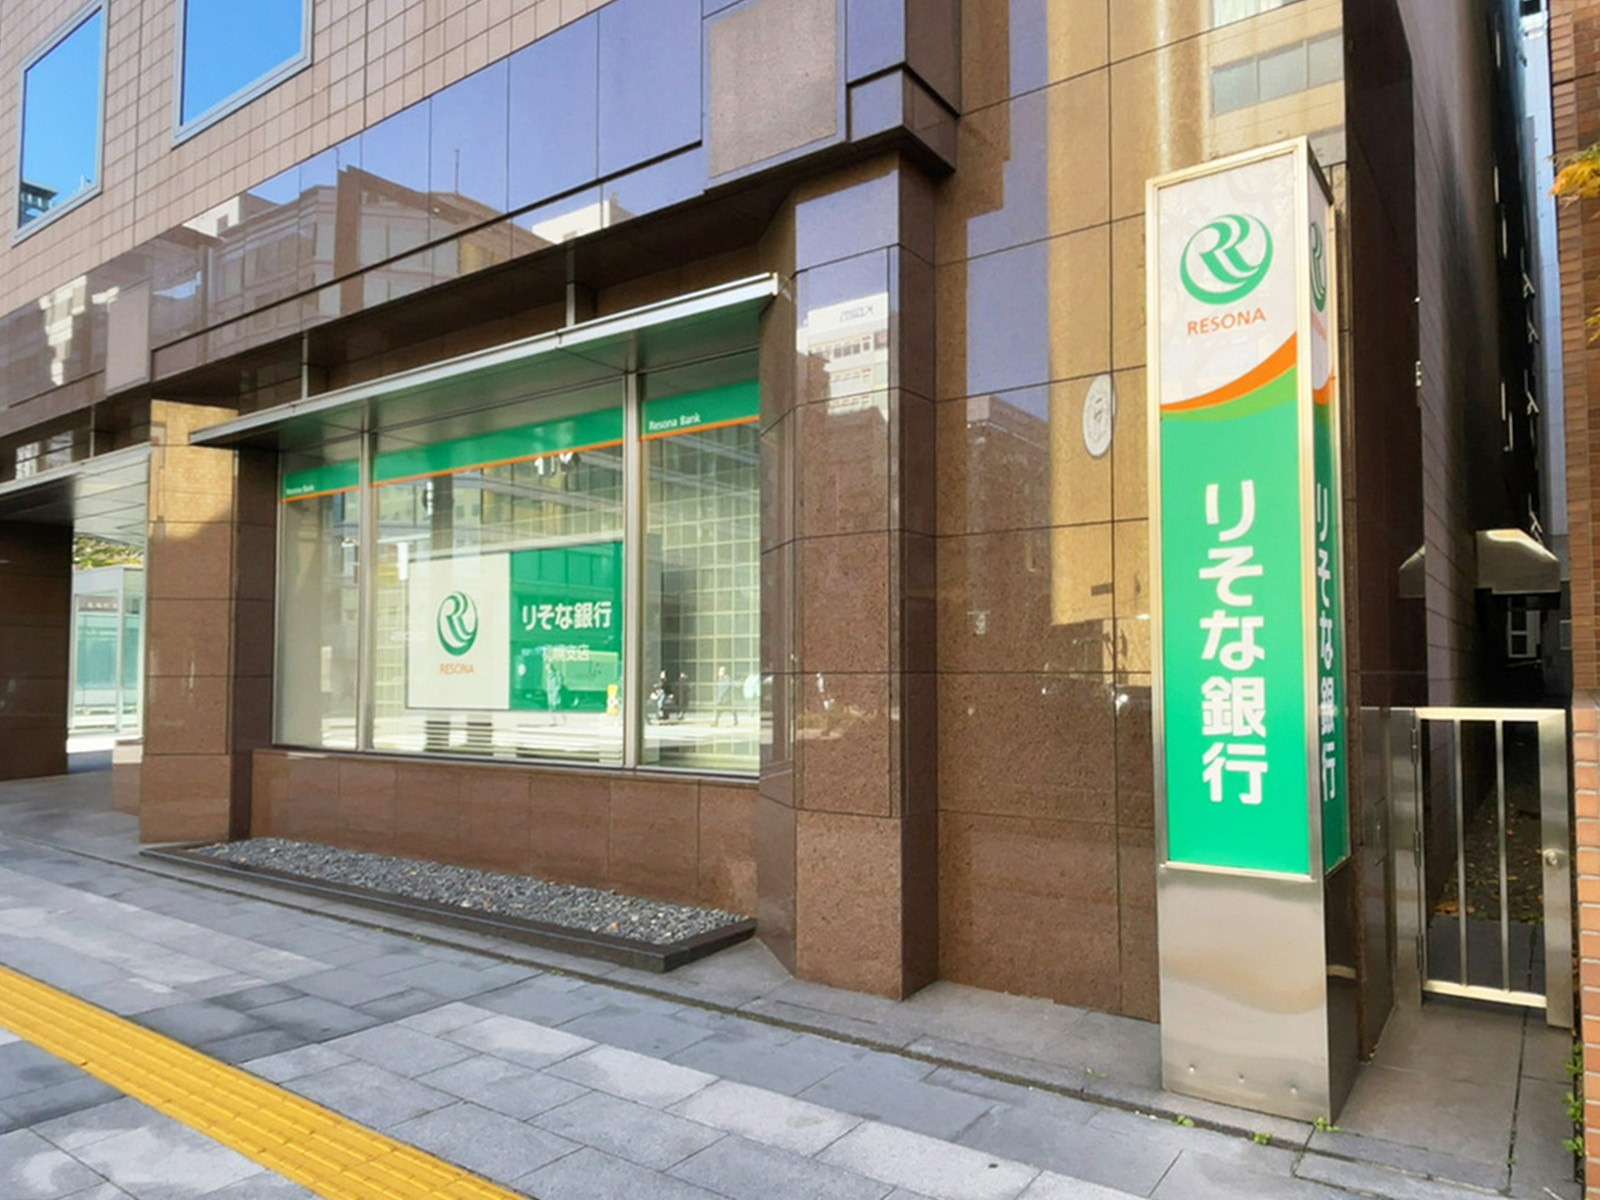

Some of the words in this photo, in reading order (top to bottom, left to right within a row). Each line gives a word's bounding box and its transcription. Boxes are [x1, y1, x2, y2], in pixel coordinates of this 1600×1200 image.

[1187, 307, 1267, 335] RESONA
[648, 419, 678, 431] Resona
[680, 412, 701, 426] Bank
[521, 601, 612, 631] りそな銀行
[1199, 479, 1268, 805] りそな銀行
[440, 663, 475, 675] RESONA
